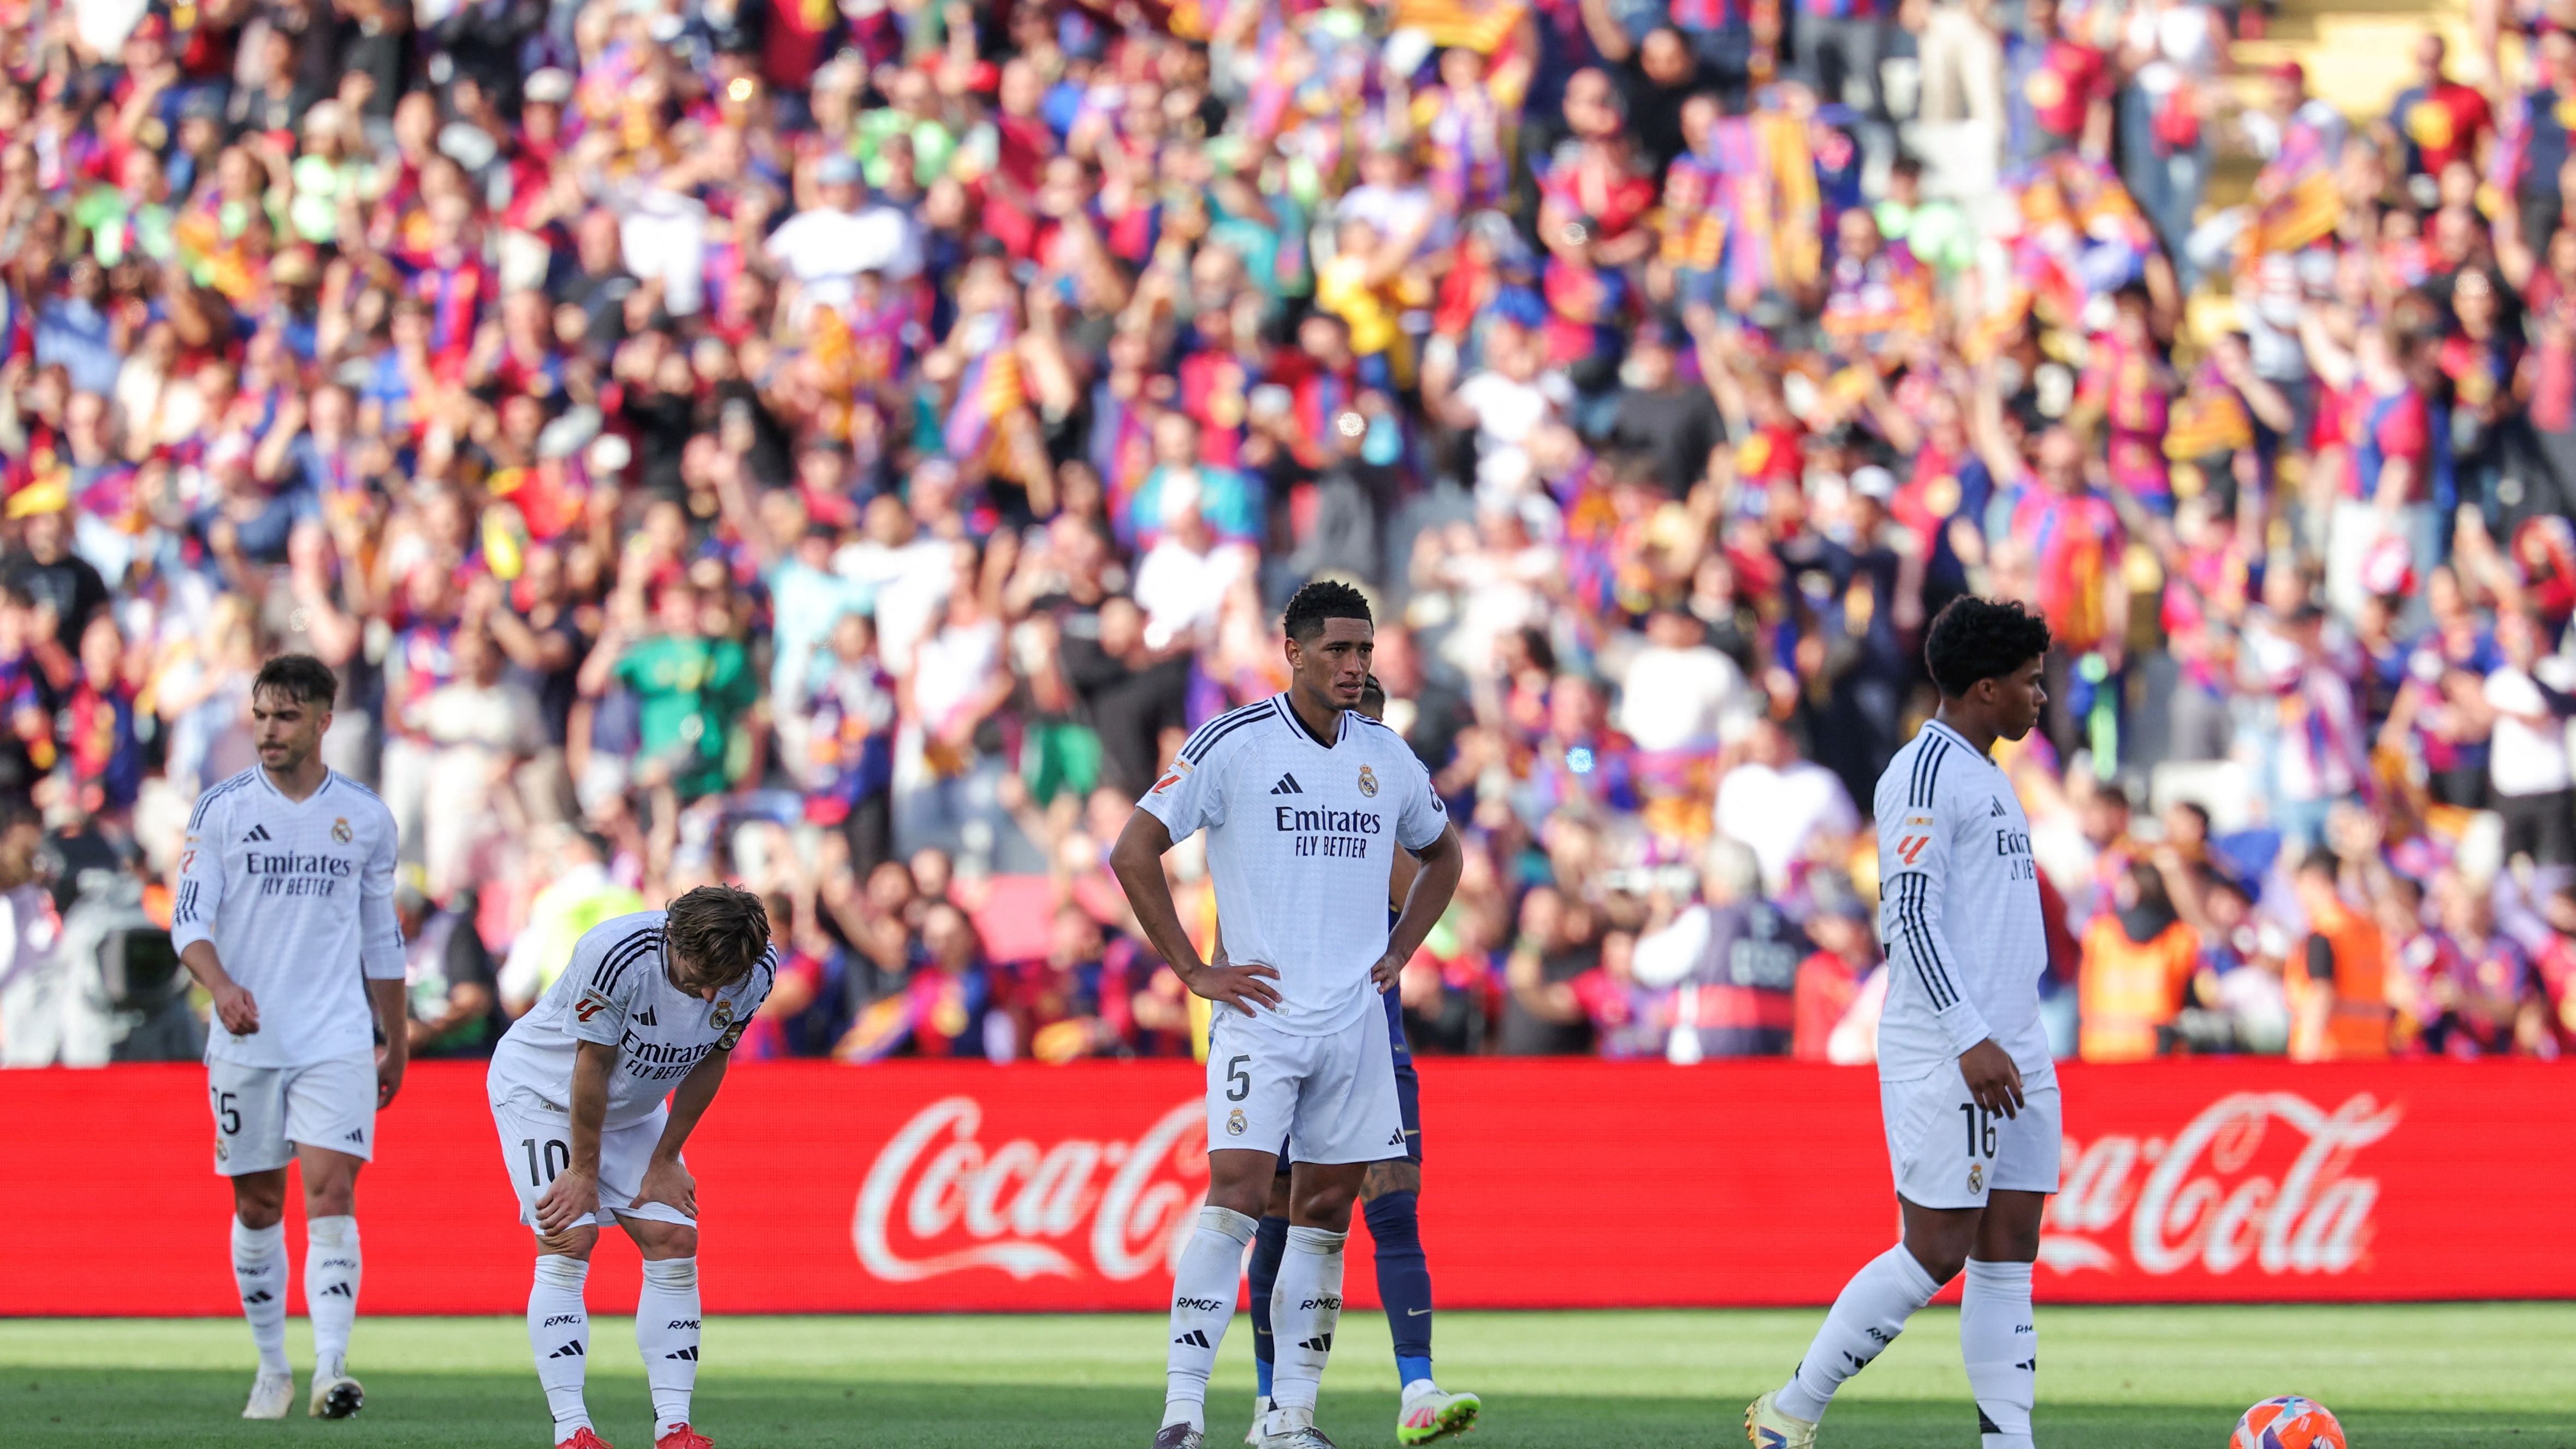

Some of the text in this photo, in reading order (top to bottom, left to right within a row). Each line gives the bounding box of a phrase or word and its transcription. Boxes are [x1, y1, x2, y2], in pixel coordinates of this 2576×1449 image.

[1275, 804, 1381, 834] Emirates
[1295, 836, 1366, 859] FLY BETTER
[247, 850, 352, 877] Emirates
[260, 878, 335, 896] FLY BETTER
[620, 1027, 714, 1063] Emirate
[625, 1059, 695, 1080] FLY BETTE
[1226, 1055, 1250, 1101] 5
[1958, 1103, 1996, 1158] 16
[522, 1138, 570, 1187] 10
[1176, 1297, 1223, 1312] RMCF
[667, 1320, 702, 1329] RMC
[2015, 1324, 2033, 1334] RM
